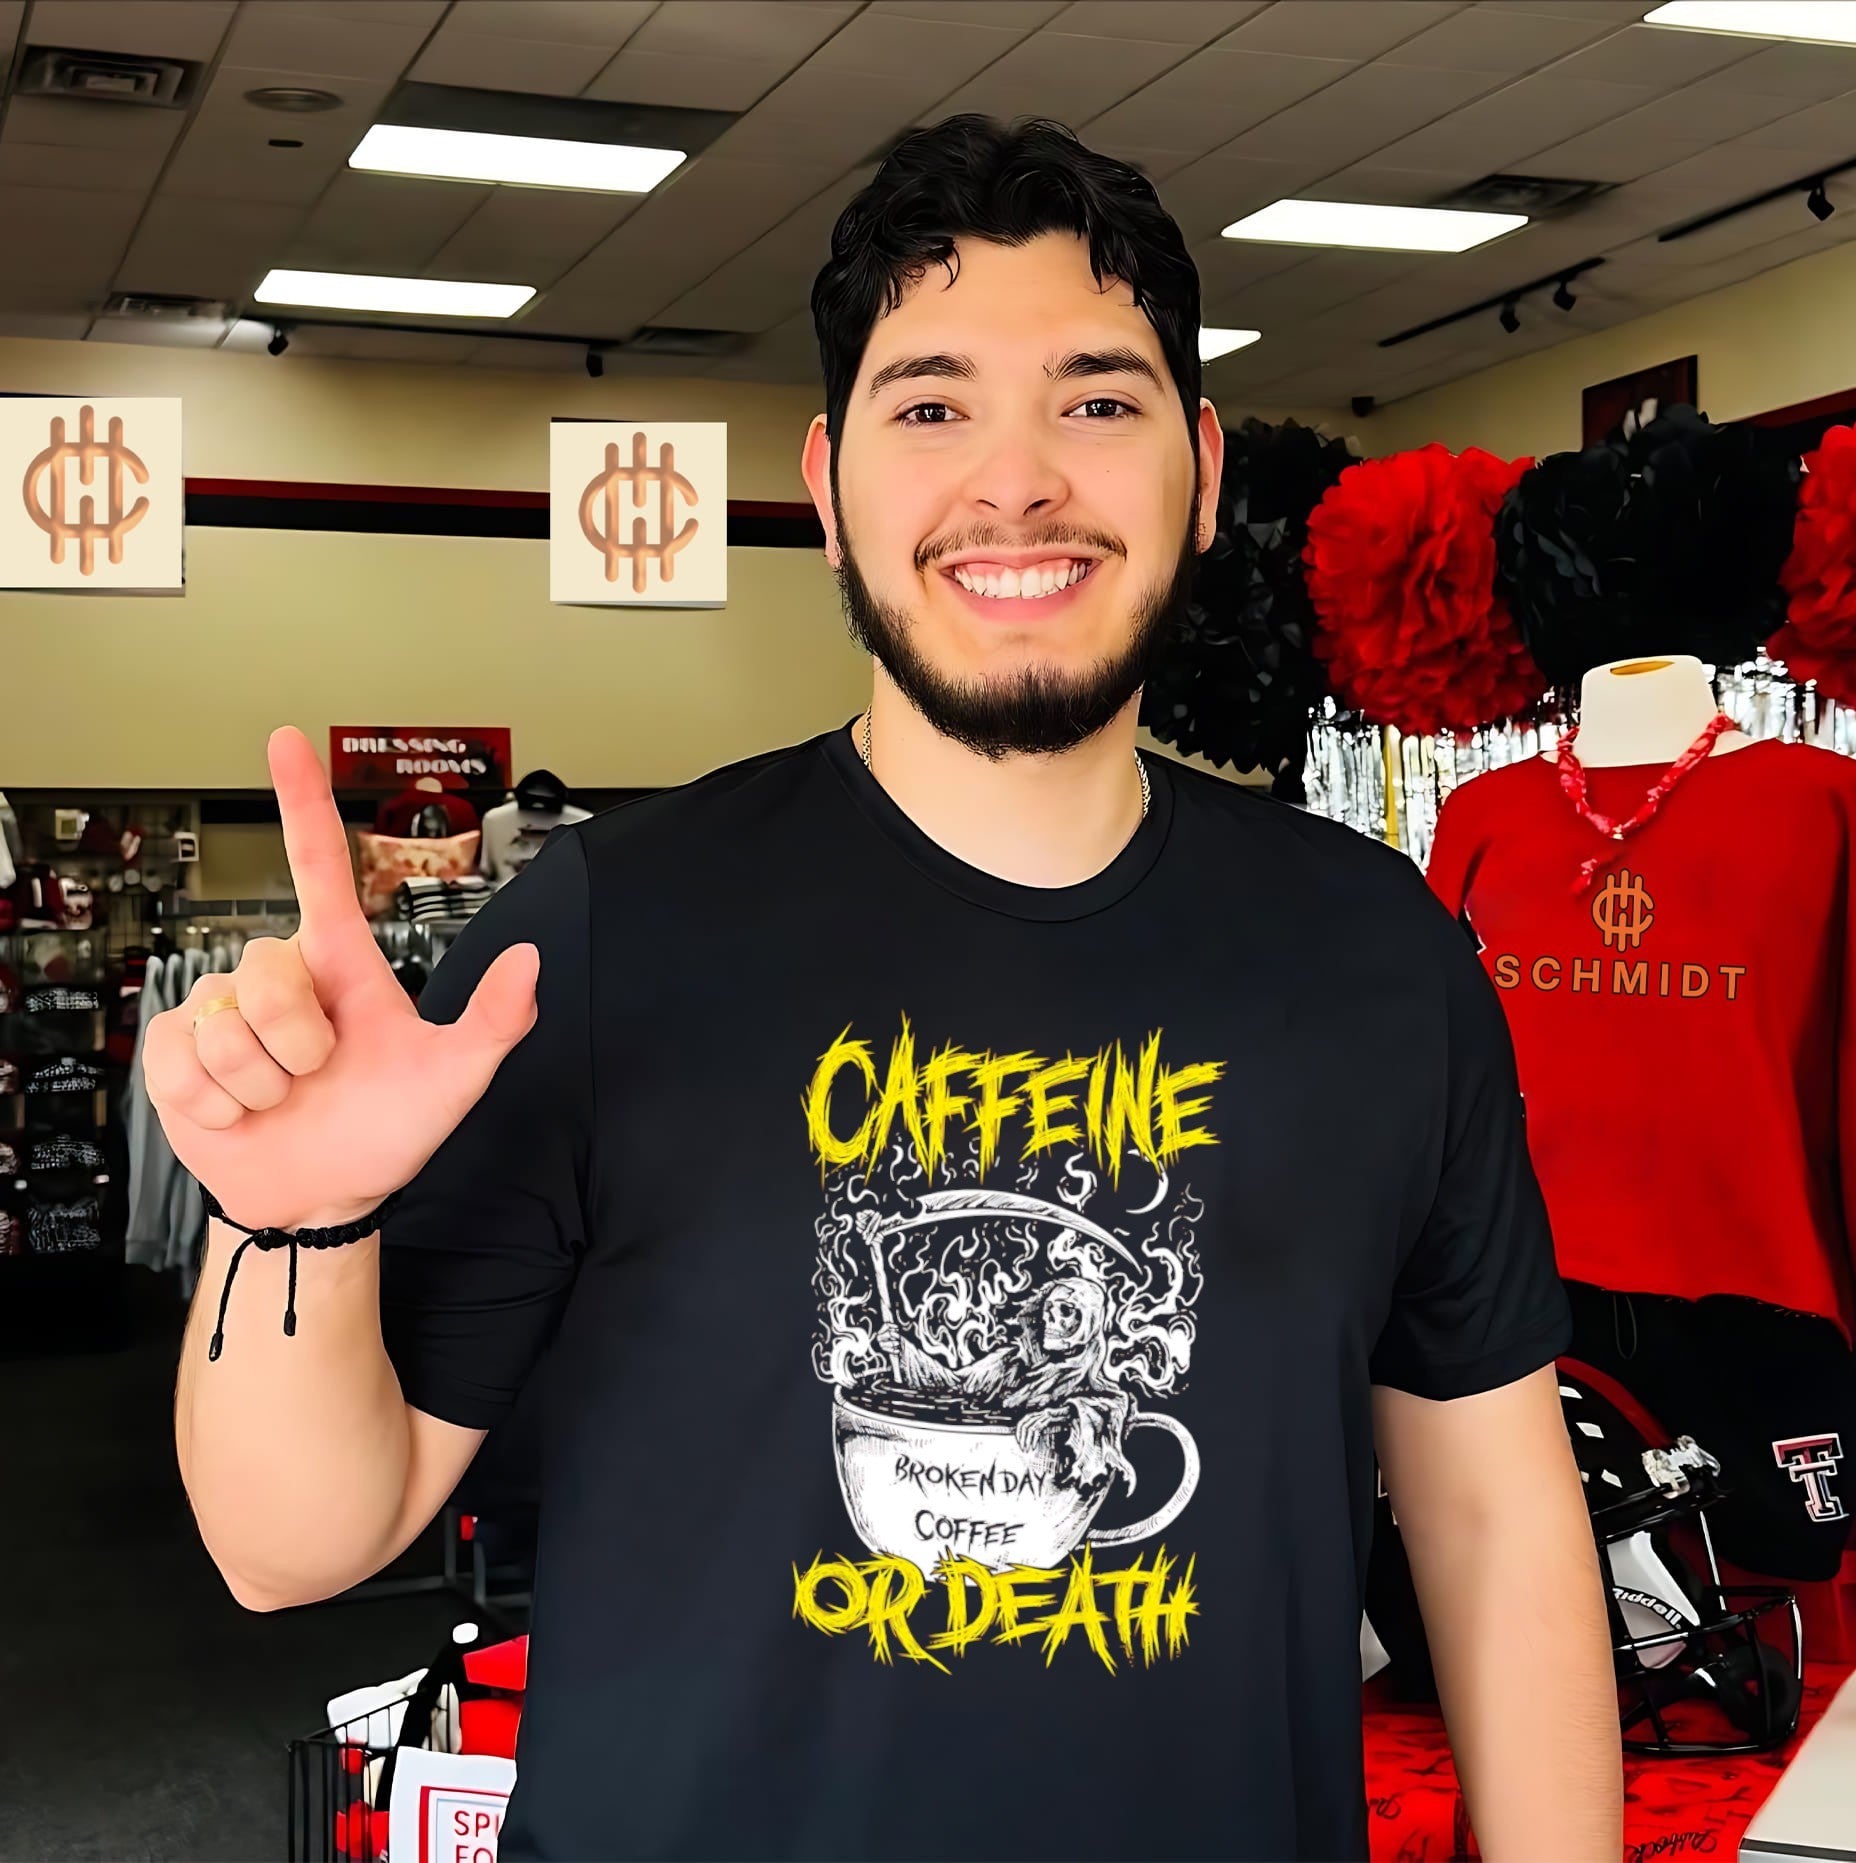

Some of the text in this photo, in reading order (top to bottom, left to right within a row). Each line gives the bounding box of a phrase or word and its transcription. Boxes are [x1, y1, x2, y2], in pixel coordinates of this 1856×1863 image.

[341, 737, 467, 754] DRESSING
[396, 758, 487, 776] ROOMS
[1493, 953, 1747, 1001] SCHMIDT
[801, 1010, 1227, 1190] CAFFEINE
[895, 1453, 1047, 1501] BROKEN DAY
[914, 1508, 1025, 1552] COFFEE
[793, 1543, 1200, 1676] OR DEATH
